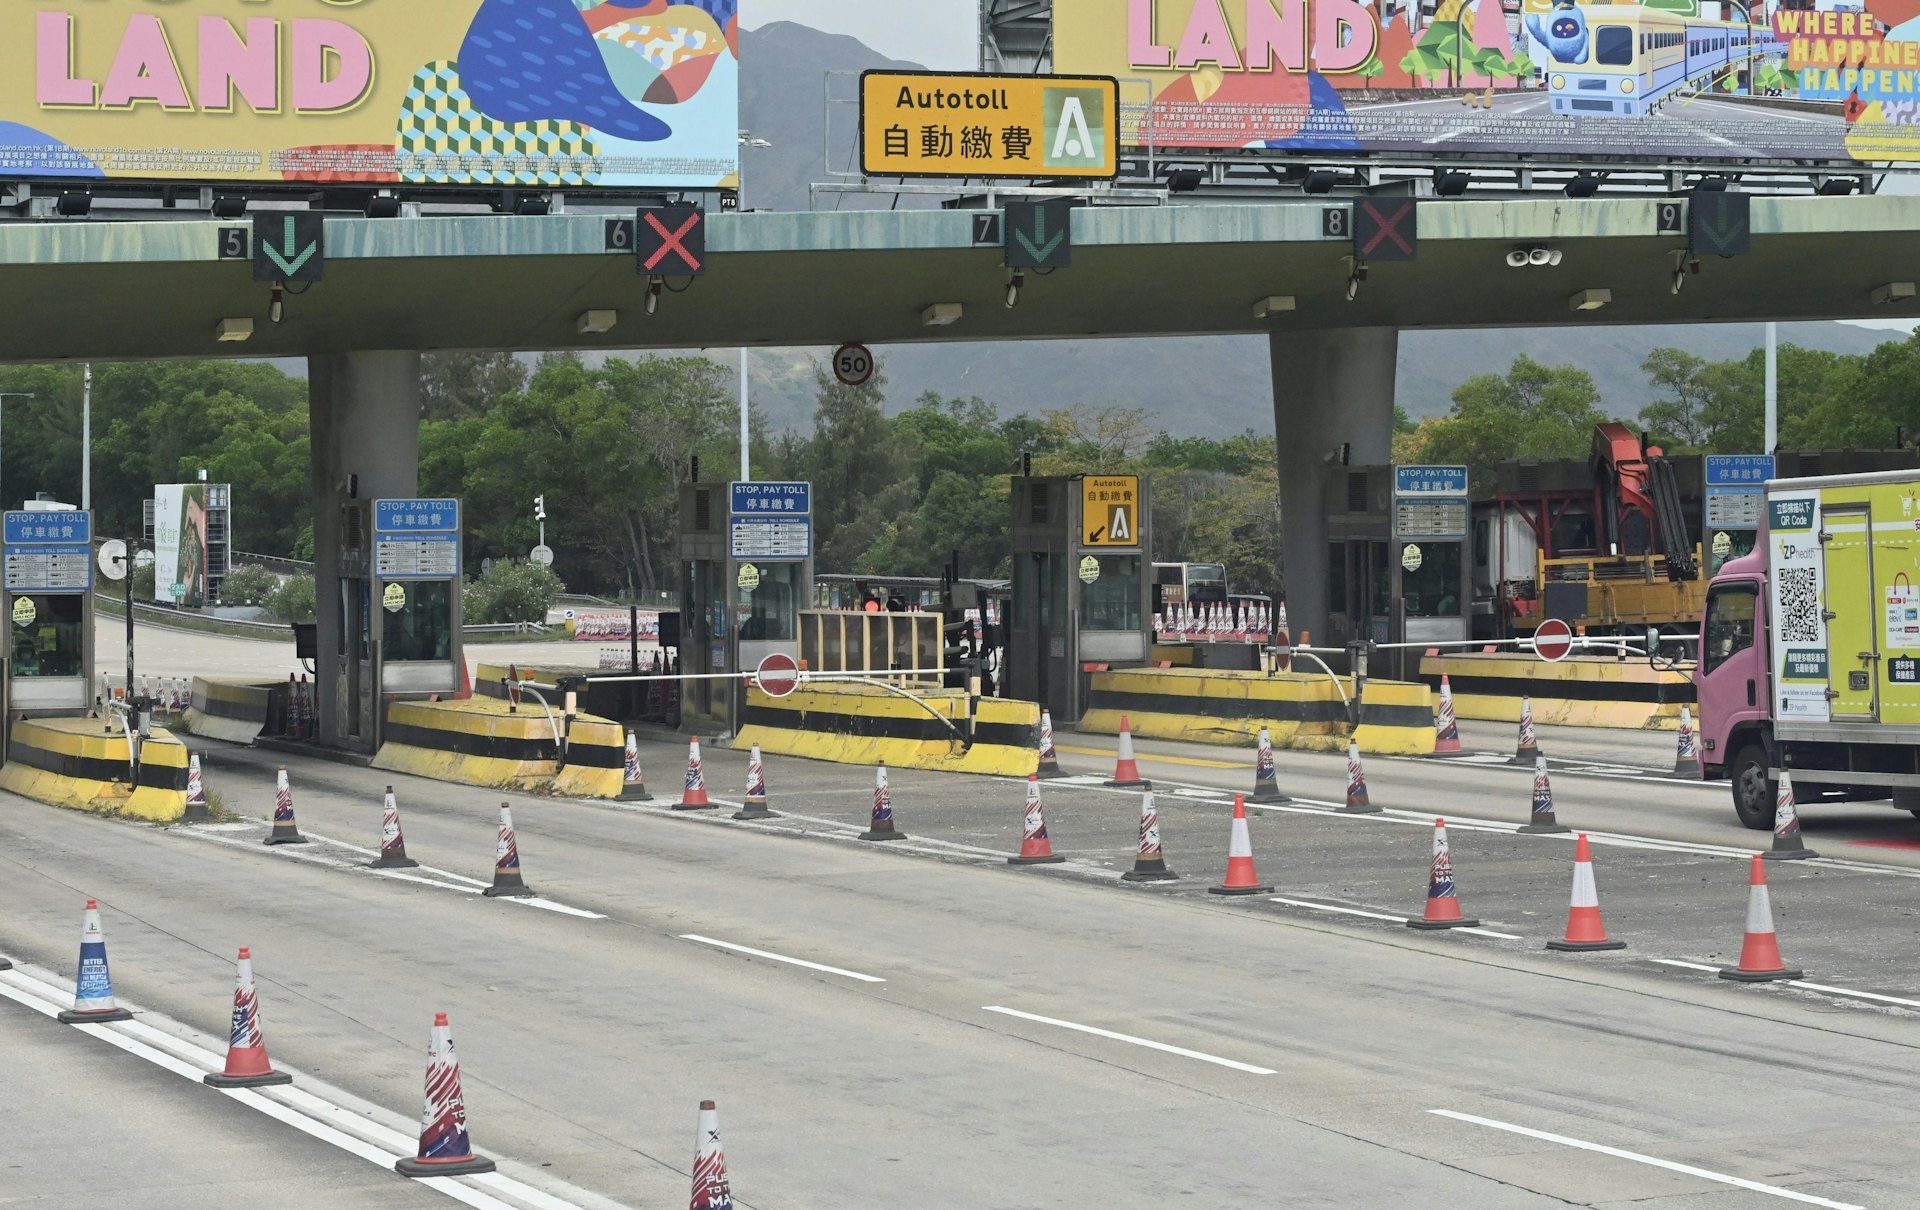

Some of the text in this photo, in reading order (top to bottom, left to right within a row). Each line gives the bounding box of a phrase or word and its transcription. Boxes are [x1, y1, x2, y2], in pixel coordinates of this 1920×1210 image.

[1775, 11, 1874, 36] WHERE
[1128, 0, 1377, 73] LAND
[36, 11, 375, 113] LAND
[896, 86, 1008, 110] Autotoll
[884, 124, 1032, 160] 自動繳費
[1328, 208, 1342, 234] 8
[1662, 204, 1676, 230] 9
[612, 221, 626, 246] 6
[980, 216, 992, 240] 7
[226, 230, 241, 256] 5
[841, 357, 866, 373] 50
[1720, 469, 1761, 479] 停車繳費
[1410, 481, 1453, 491] 停車繳費
[746, 498, 794, 510] 停車繳費
[1088, 491, 1132, 501] 自動繳費
[411, 502, 428, 510] PAY
[431, 502, 453, 510] TOLL
[41, 514, 59, 522] PAY
[62, 514, 85, 522] TOLL
[392, 514, 442, 526] 停車繳費
[1781, 515, 1807, 526] QR Code
[21, 526, 73, 538] 停車繳費
[707, 1186, 721, 1194] TO
